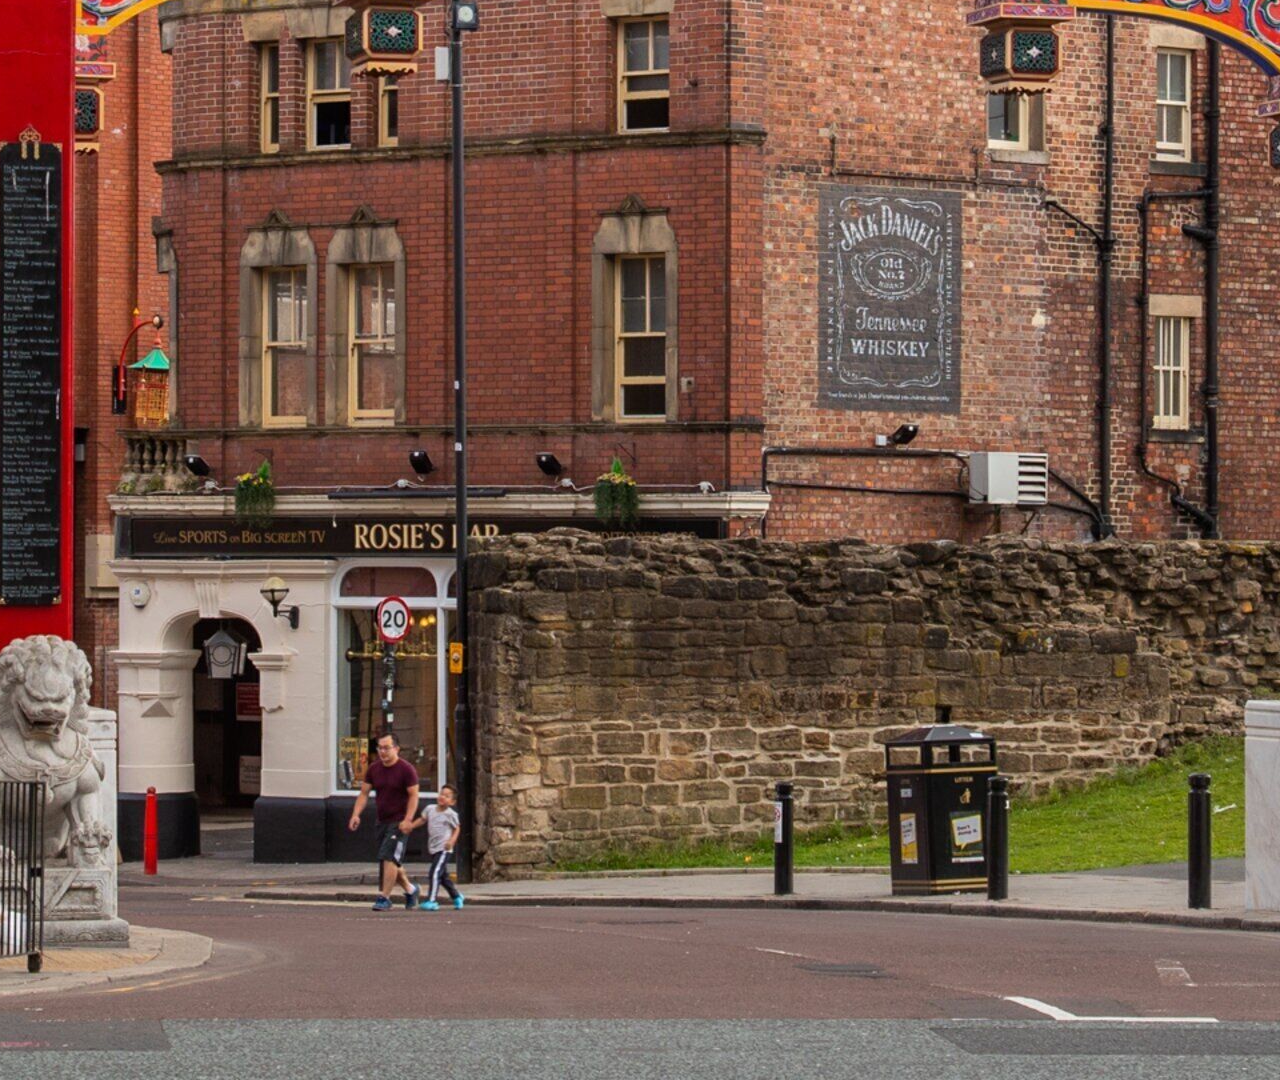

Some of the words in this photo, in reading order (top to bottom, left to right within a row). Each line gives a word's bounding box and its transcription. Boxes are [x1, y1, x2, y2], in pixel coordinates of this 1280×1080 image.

[839, 213, 878, 252] JACK
[881, 205, 944, 257] DANIEL'S
[879, 258, 903, 269] Old
[856, 306, 929, 333] Tennessee
[851, 338, 930, 358] WHISKEY
[153, 531, 178, 544] Live
[179, 529, 228, 544] SPORTS
[229, 535, 241, 544] on
[264, 530, 307, 544] SCREEN
[309, 530, 326, 544] TV
[354, 522, 444, 549] ROSIE'S
[382, 609, 407, 630] 20
